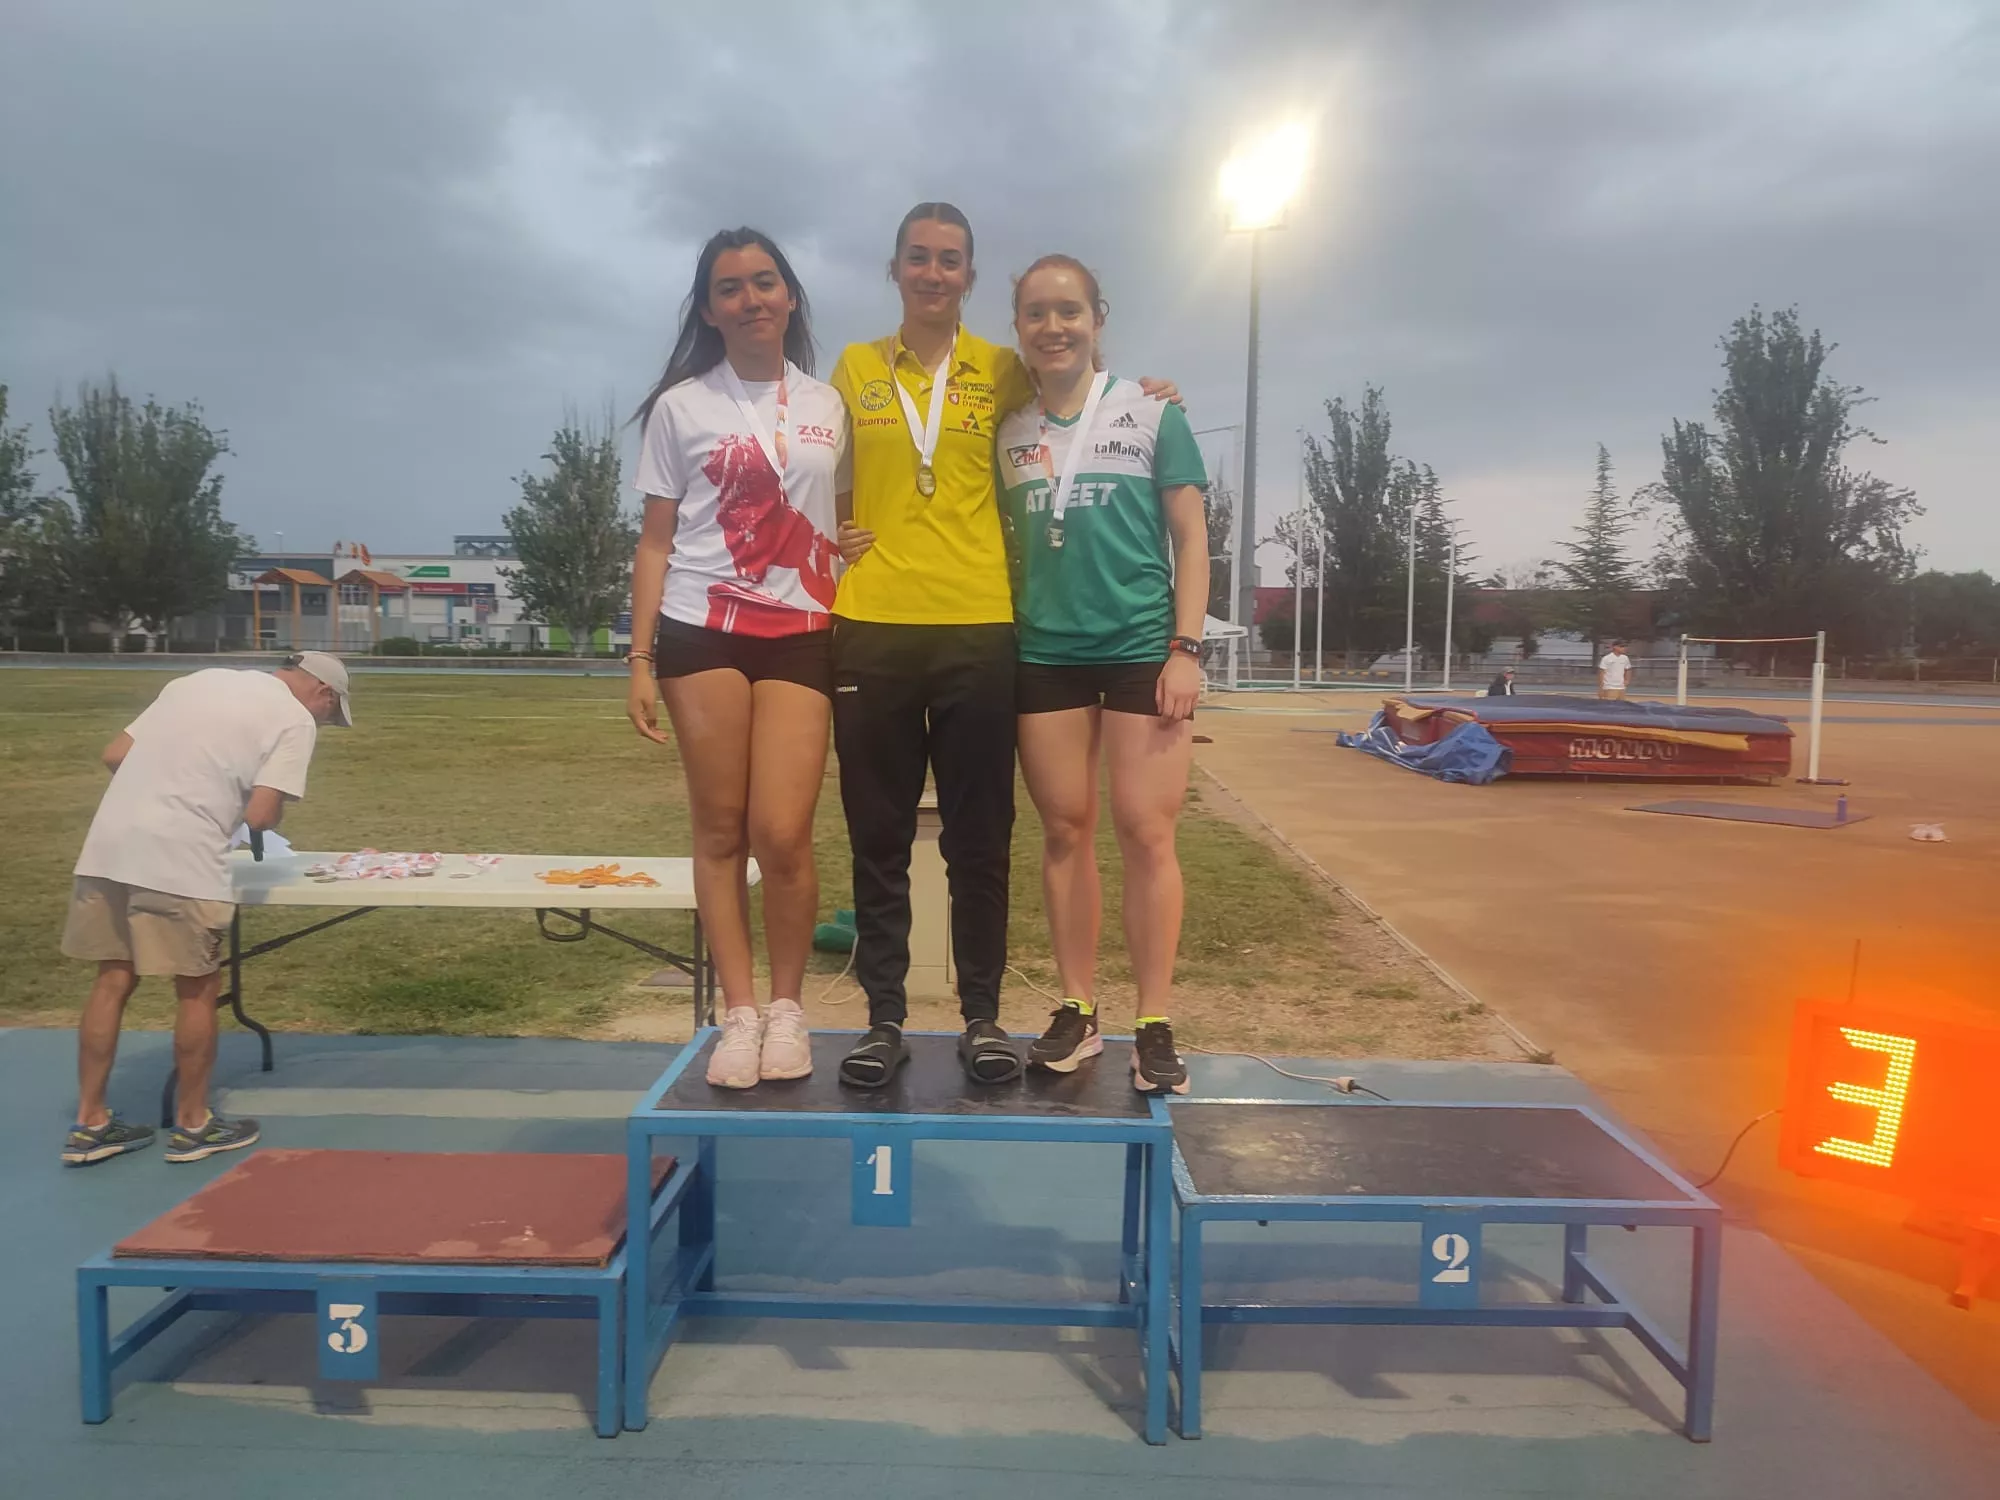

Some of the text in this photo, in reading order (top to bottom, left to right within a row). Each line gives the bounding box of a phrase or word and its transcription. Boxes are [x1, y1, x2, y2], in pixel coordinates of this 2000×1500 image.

[796, 425, 834, 441] ZGZ
[1568, 738, 1679, 761] MONDO
[1813, 1025, 1917, 1168] 3
[866, 1146, 894, 1195] 1
[1431, 1233, 1470, 1283] 2
[328, 1304, 368, 1354] 3
